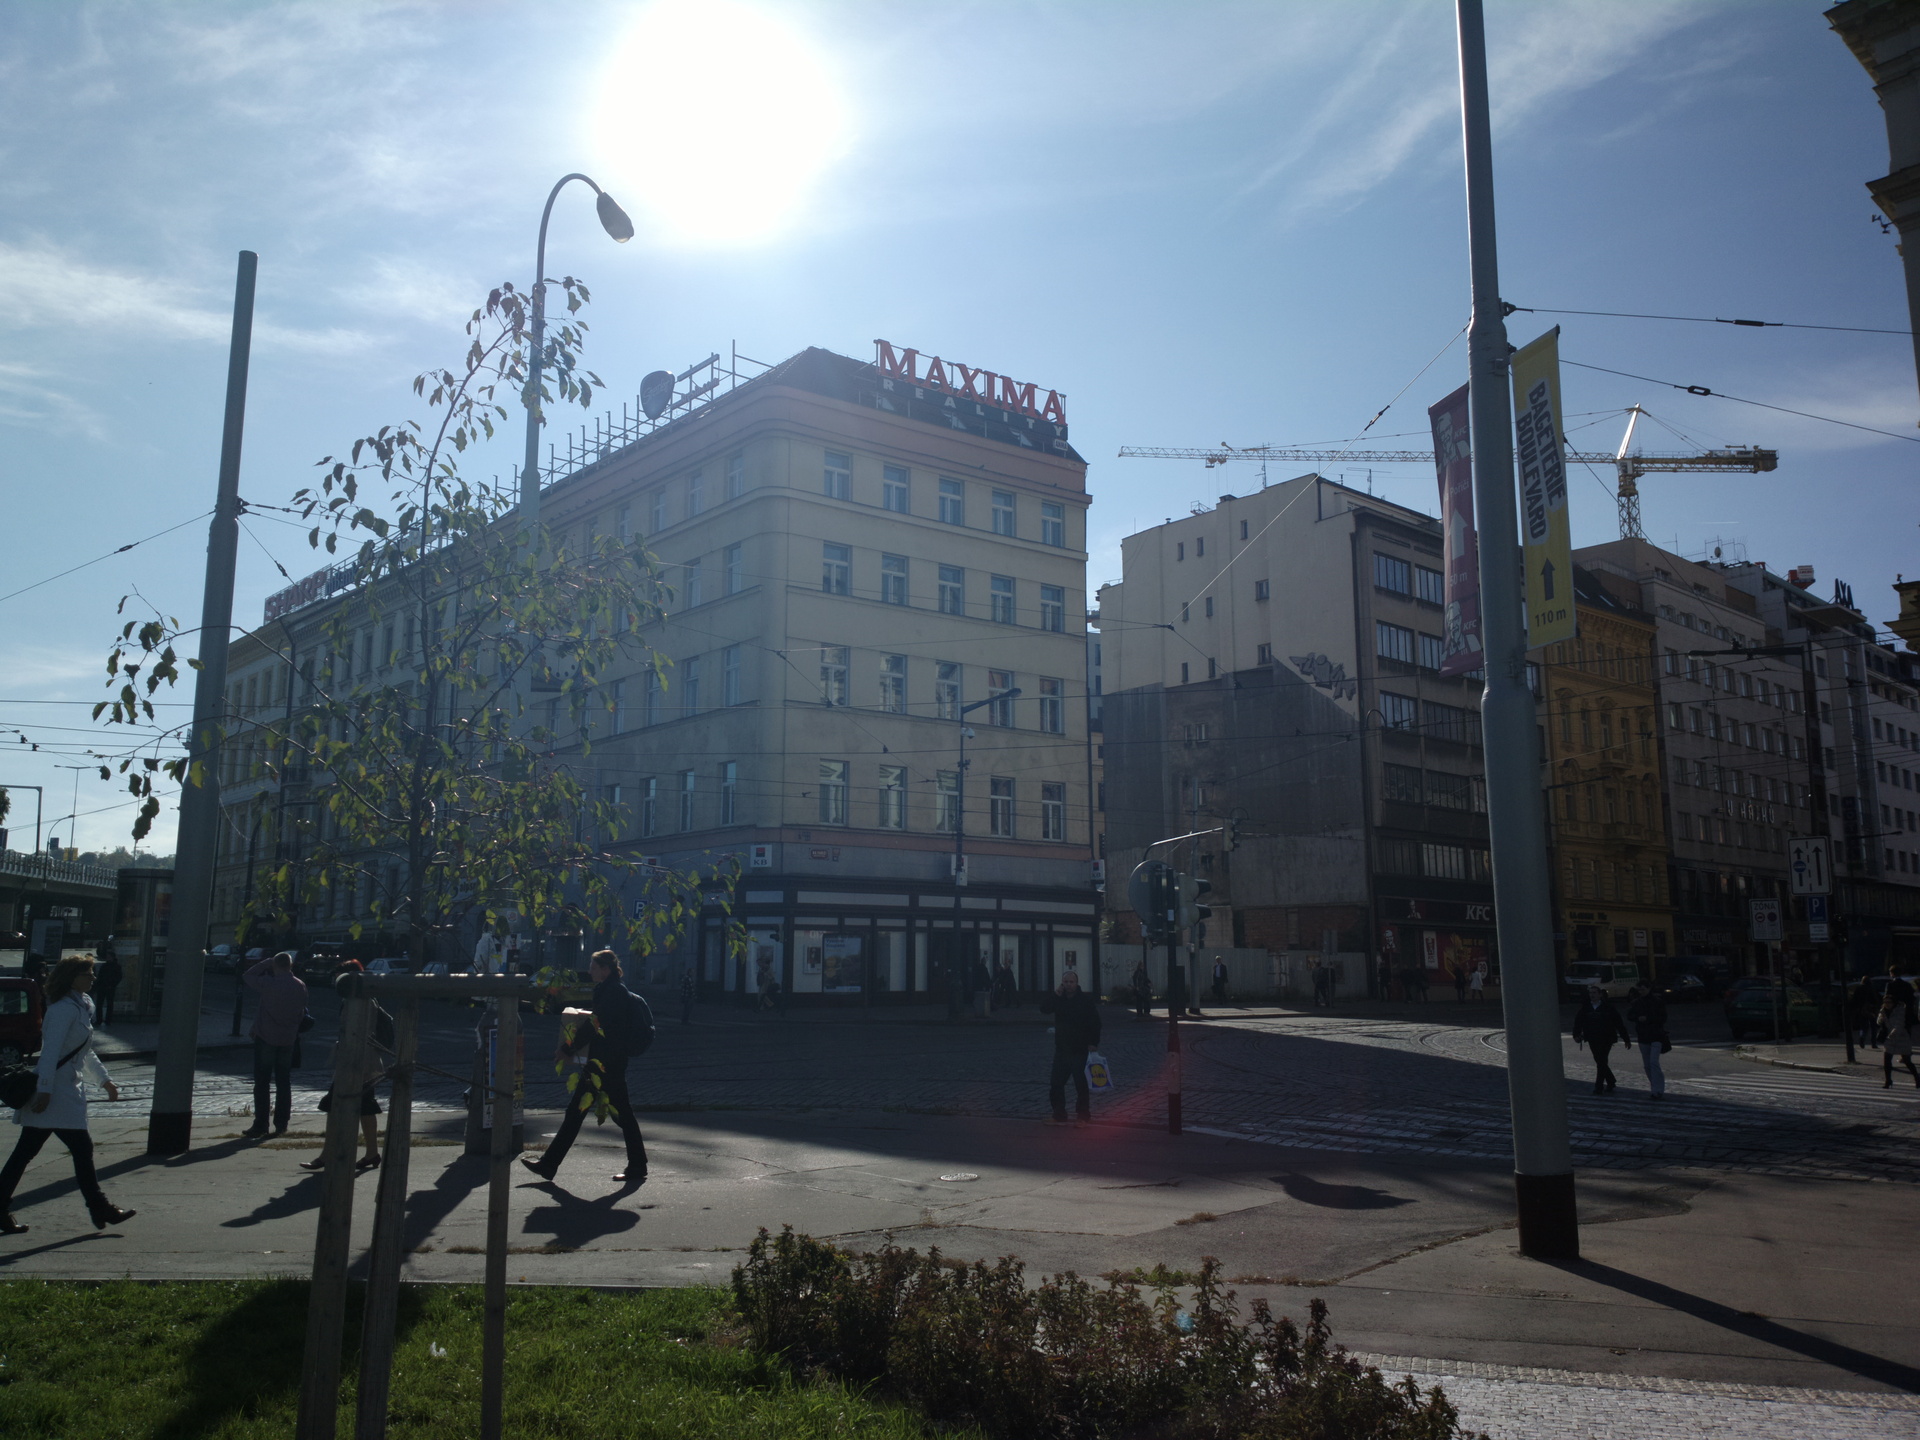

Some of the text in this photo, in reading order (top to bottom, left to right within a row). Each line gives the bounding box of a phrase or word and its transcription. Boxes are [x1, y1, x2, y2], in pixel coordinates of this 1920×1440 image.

[874, 339, 1067, 426] MAXIMA
[883, 379, 1063, 436] REALITY
[1453, 425, 1468, 440] KFC
[1529, 381, 1566, 506] BAGETERIE
[1516, 412, 1547, 539] BOULEVARD
[265, 570, 328, 620] SHARP
[1835, 578, 1855, 610] AXA
[1463, 620, 1477, 631] KFC
[1535, 609, 1567, 627] 110 m
[1726, 799, 1734, 817] U
[635, 901, 645, 914] P
[1465, 904, 1491, 921] KFC
[1812, 898, 1820, 914] P
